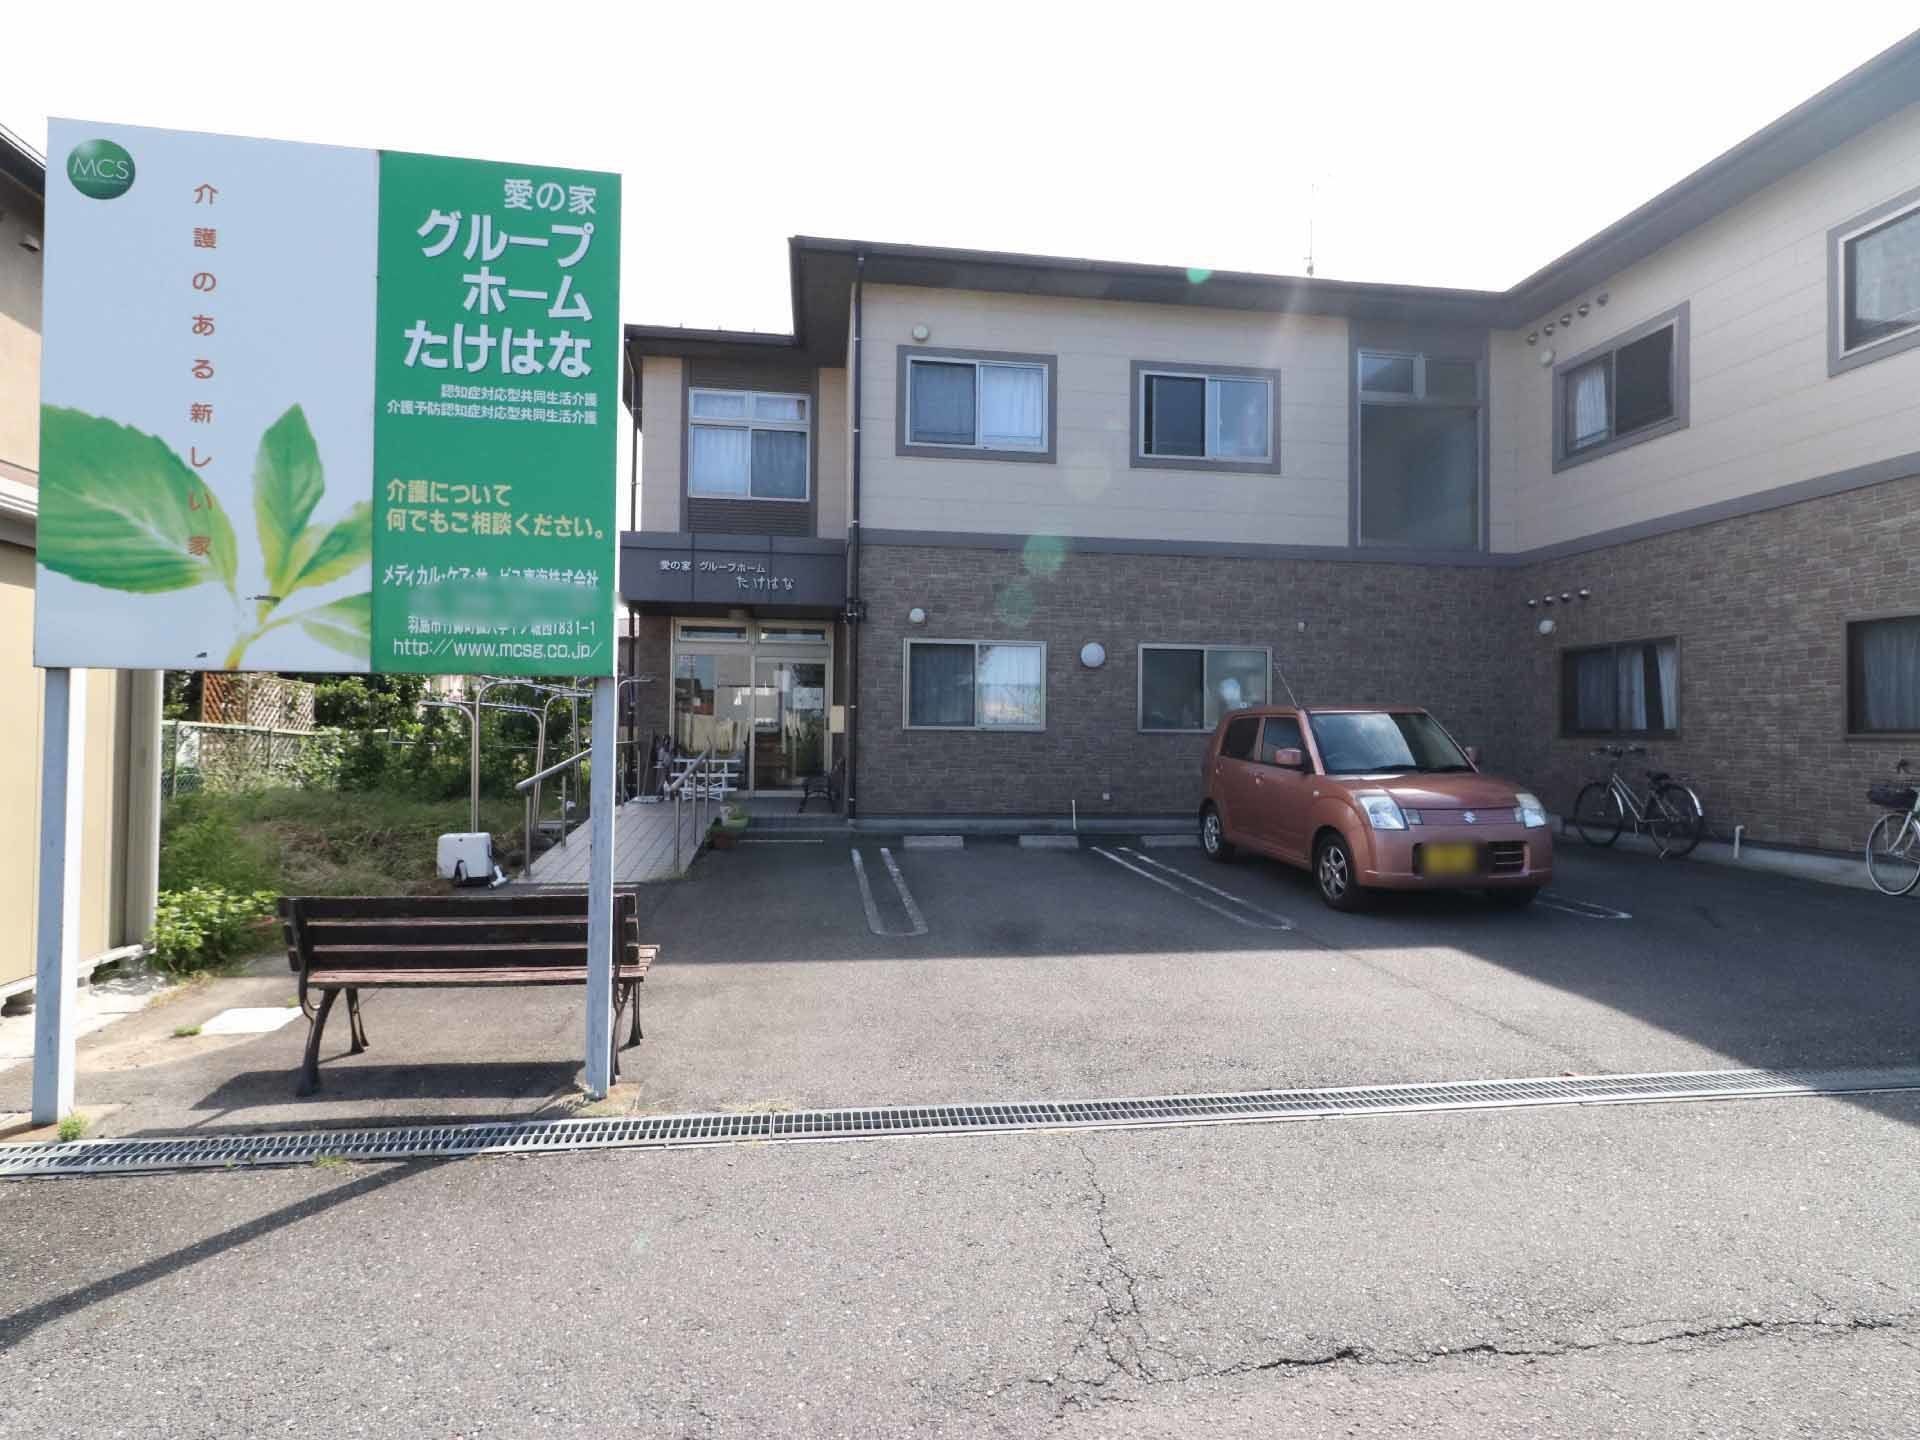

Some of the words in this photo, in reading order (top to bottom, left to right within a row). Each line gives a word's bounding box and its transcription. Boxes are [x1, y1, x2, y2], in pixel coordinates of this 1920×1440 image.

[73, 156, 129, 179] MCS
[504, 178, 597, 215] 愛の家
[416, 209, 595, 269] グループ
[462, 266, 594, 322] ホーム
[403, 319, 593, 379] たけはな
[188, 183, 219, 557] 介護のある新しい家
[441, 383, 598, 408] 認知症対応型共同生活介護
[387, 399, 598, 425] 介護予防認知症対応型共同生活介護
[386, 478, 512, 506] 介護について
[386, 508, 603, 540] 何でもご相談ください。
[660, 559, 692, 572] 愛の家
[699, 560, 767, 573] グループホーム
[736, 575, 794, 590] たけはな
[393, 638, 603, 660] http://www.mcsg.co.jp/
